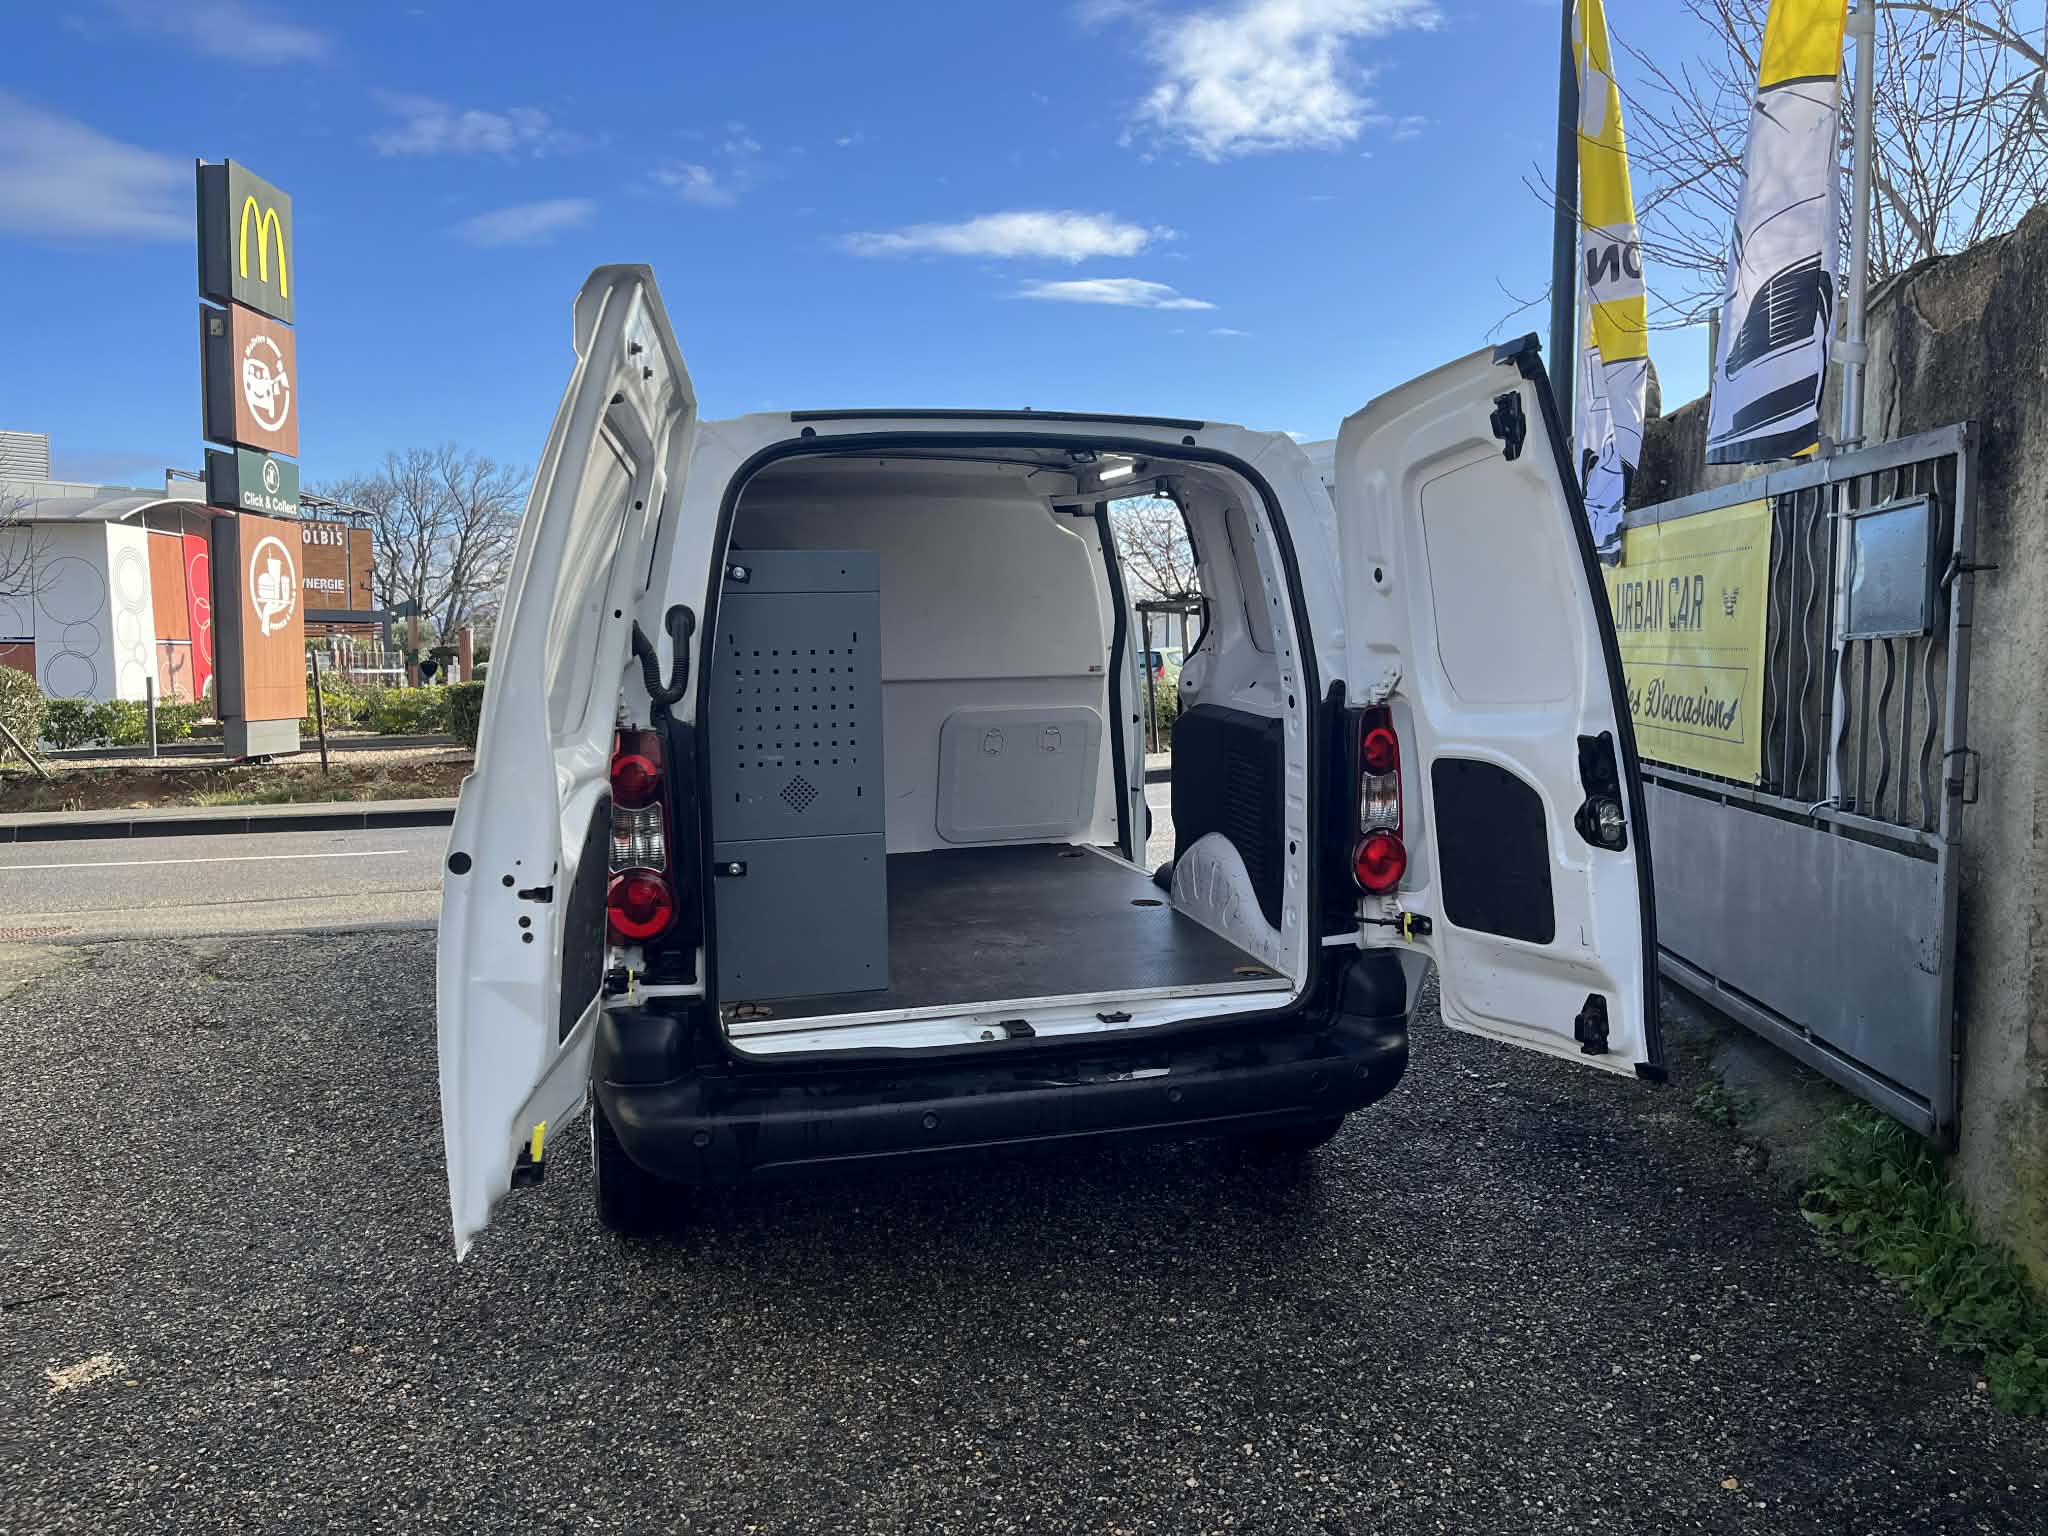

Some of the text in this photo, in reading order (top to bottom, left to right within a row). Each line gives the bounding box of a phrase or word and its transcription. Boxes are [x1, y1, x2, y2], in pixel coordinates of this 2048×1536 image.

[244, 491, 297, 515] Click & Collect
[302, 529, 343, 546] OLBIS
[1616, 575, 1704, 632] URBAN CAR
